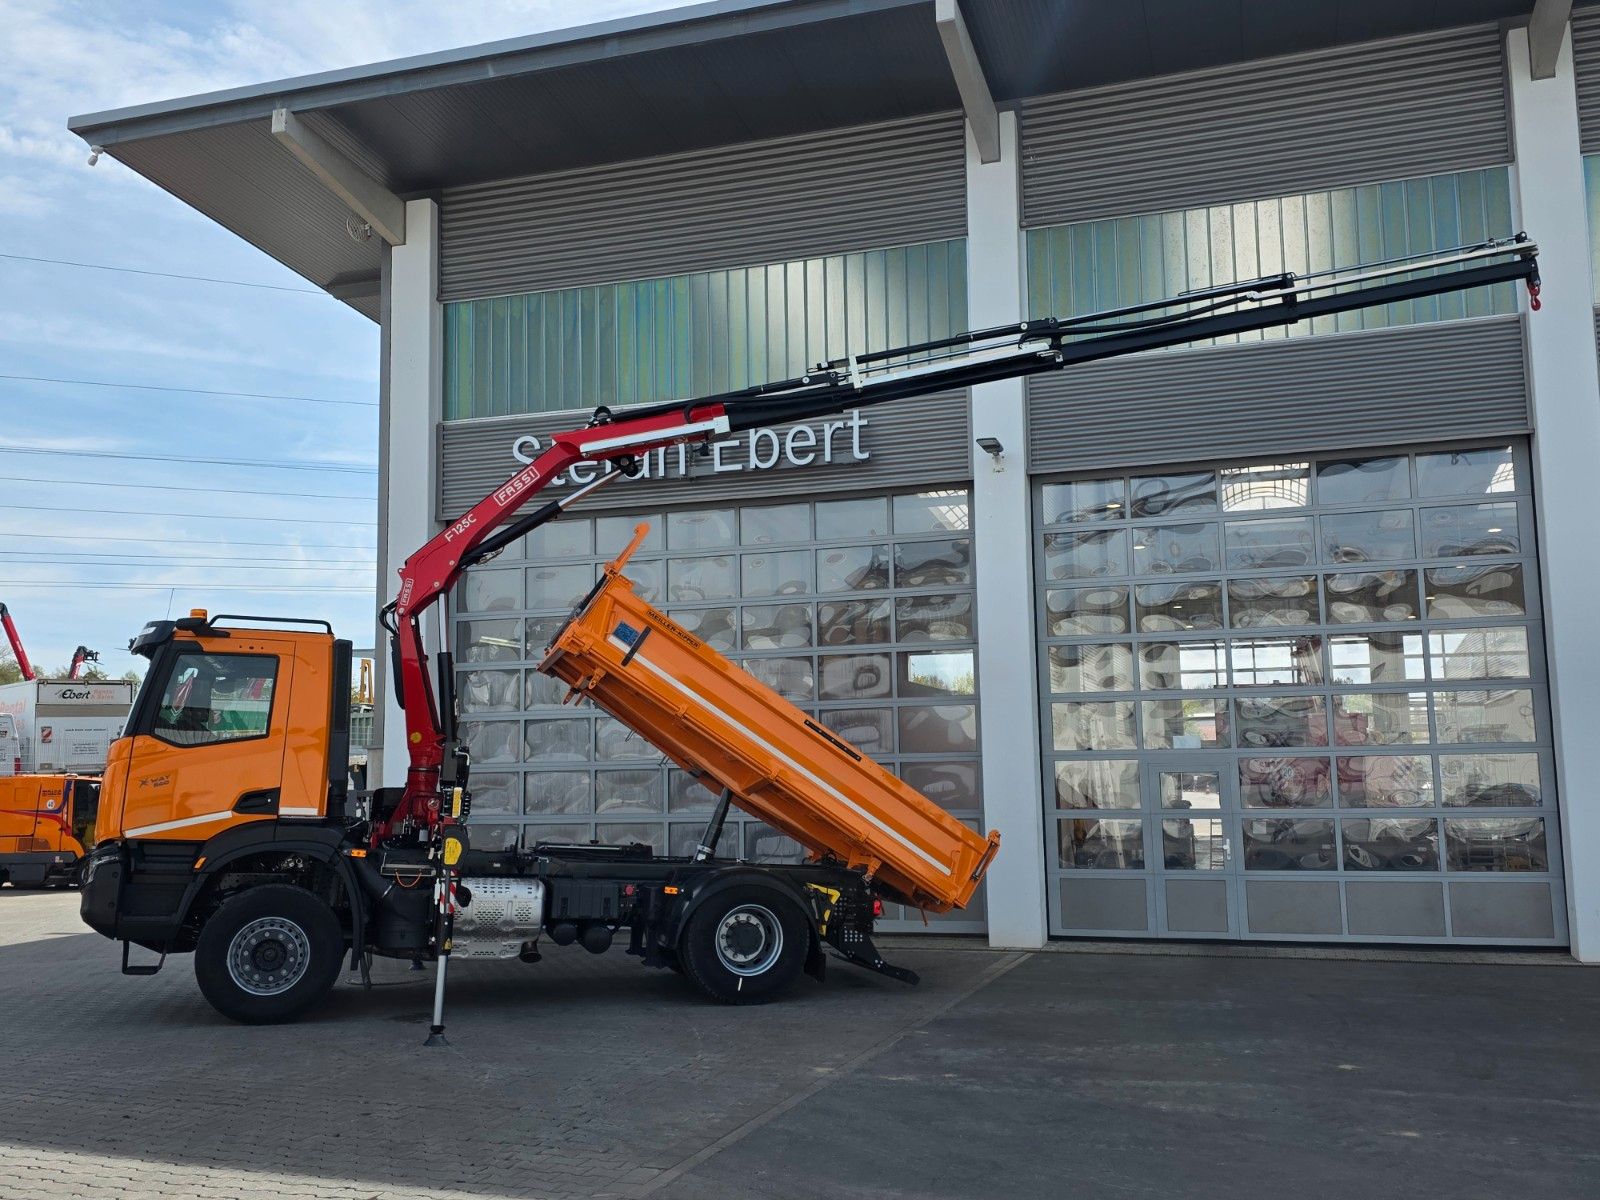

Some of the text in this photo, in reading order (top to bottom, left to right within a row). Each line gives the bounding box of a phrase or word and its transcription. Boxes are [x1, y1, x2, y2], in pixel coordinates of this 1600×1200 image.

[512, 409, 870, 485] Sean Ebert
[497, 469, 537, 503] FASSI
[61, 689, 91, 699] Ebert
